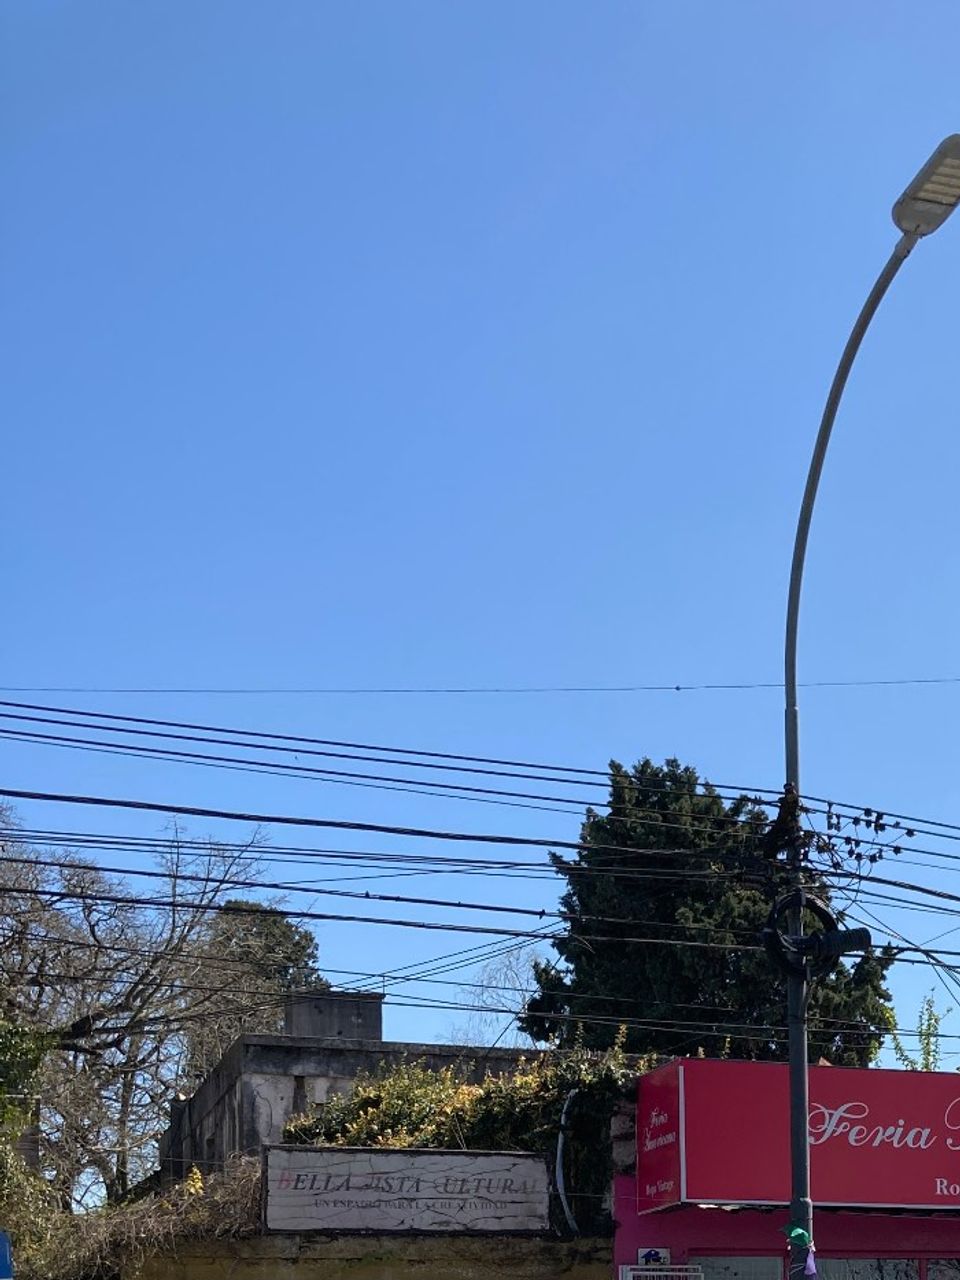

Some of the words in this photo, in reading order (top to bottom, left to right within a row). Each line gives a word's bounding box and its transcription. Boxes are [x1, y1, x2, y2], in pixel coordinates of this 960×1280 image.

[807, 1102, 938, 1150] Feria
[277, 1170, 351, 1191] BELLA
[362, 1174, 421, 1193] ISTA
[434, 1177, 538, 1194] ULTURAL
